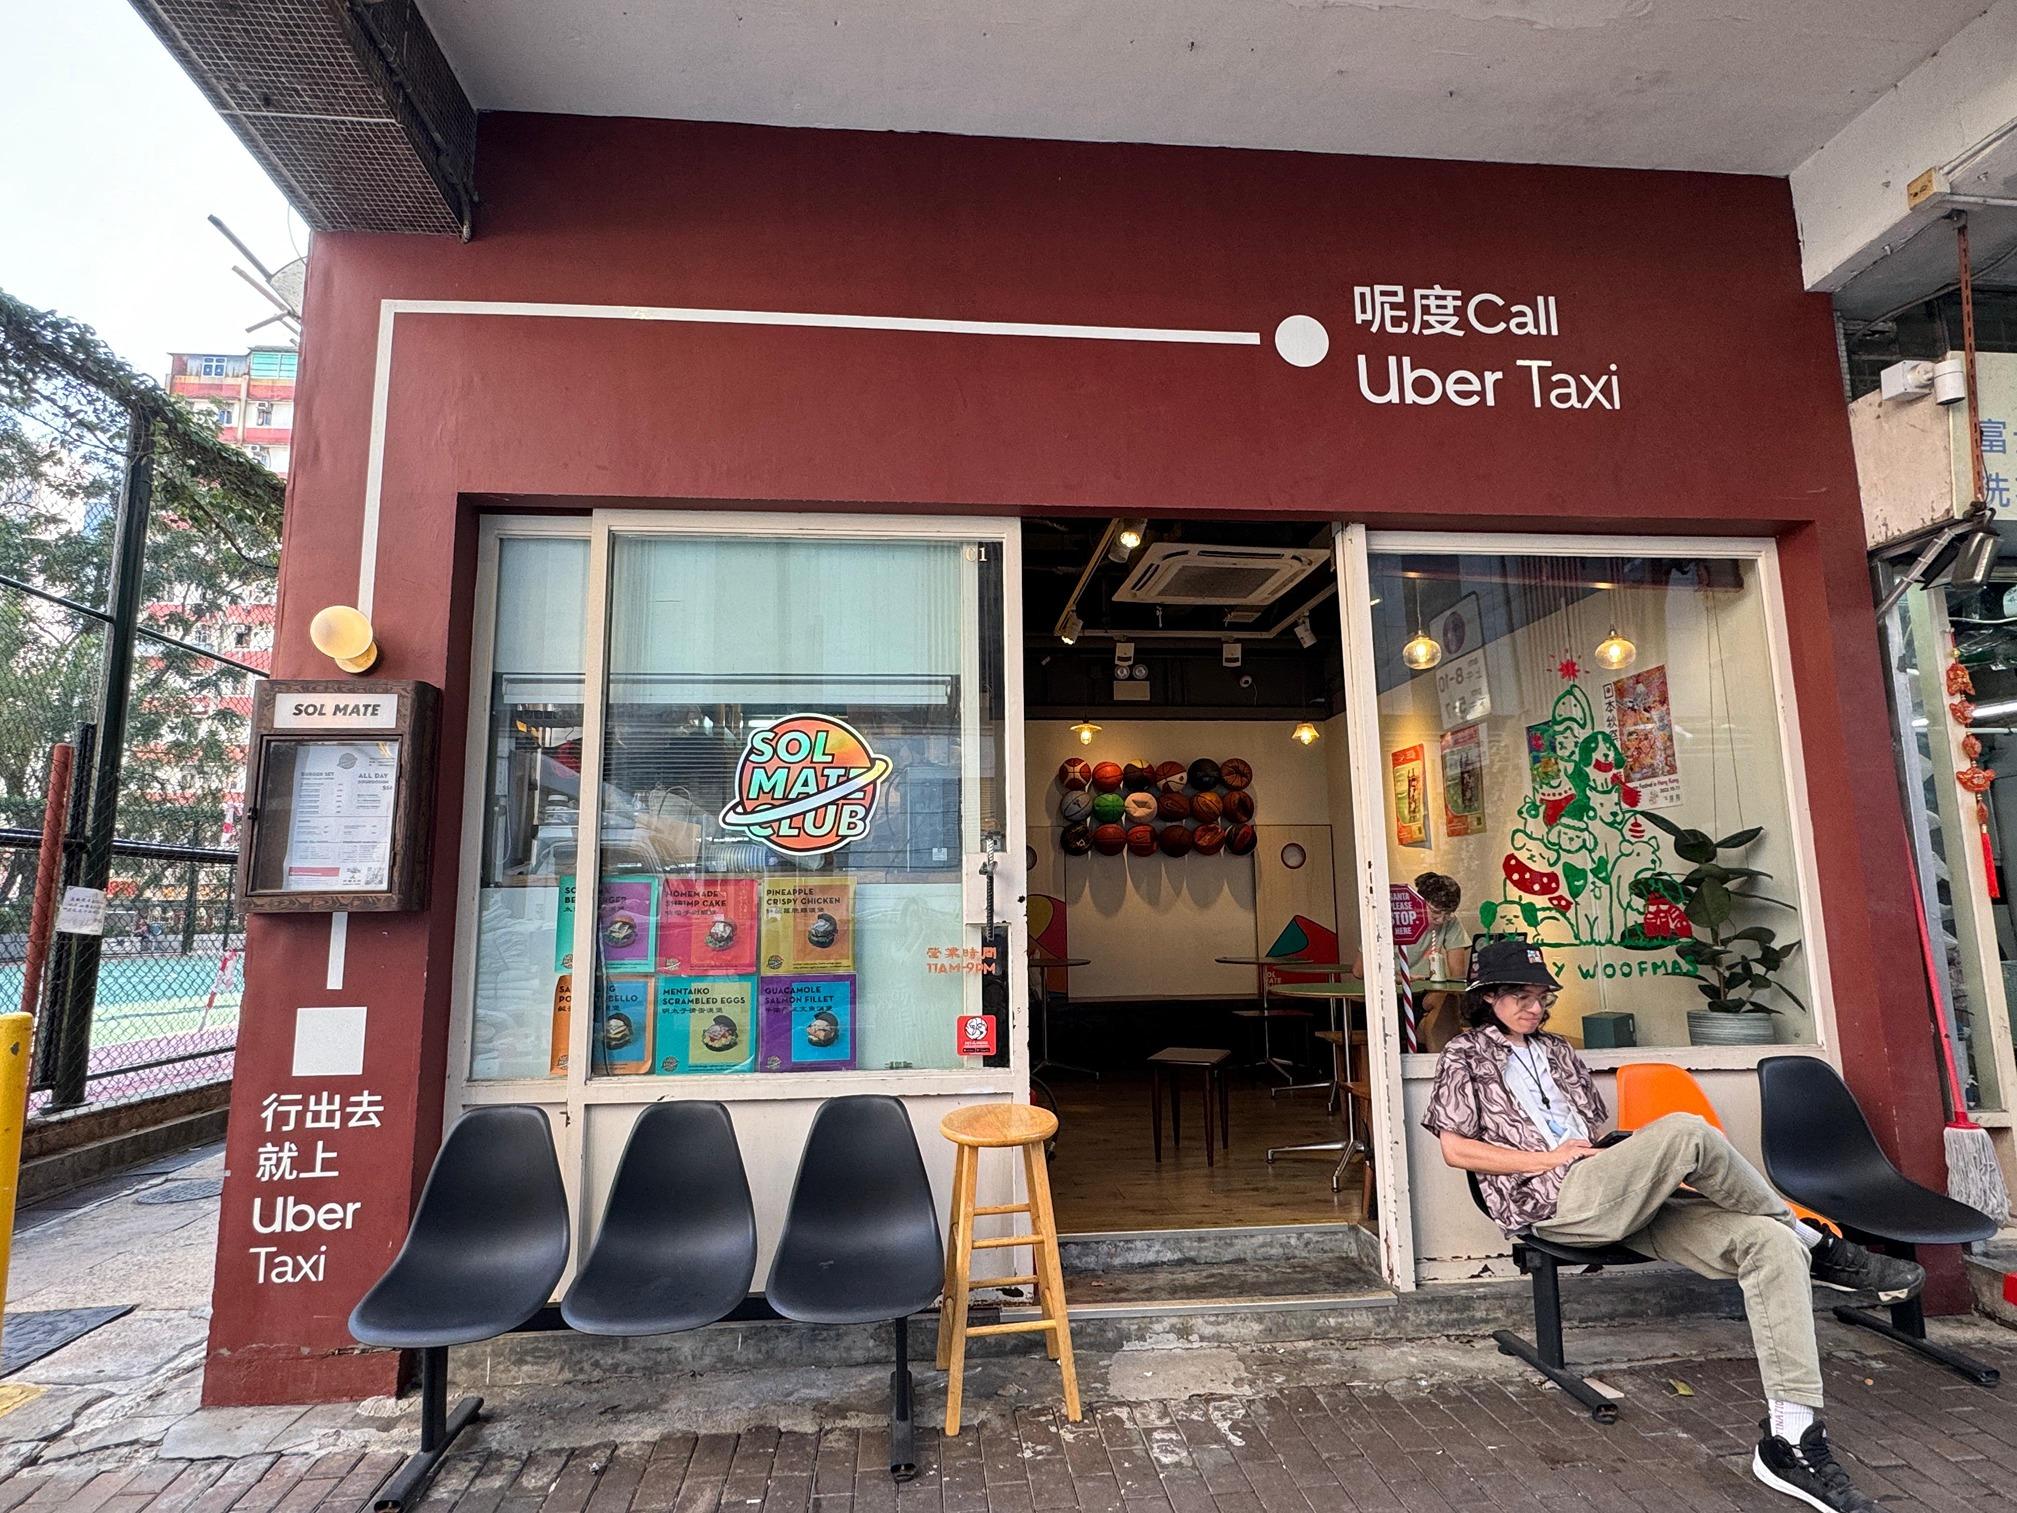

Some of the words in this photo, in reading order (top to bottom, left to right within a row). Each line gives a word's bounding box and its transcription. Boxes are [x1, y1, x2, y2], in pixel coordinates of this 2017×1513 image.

[1357, 354, 1503, 406] Uber
[1516, 359, 1621, 410] Taxi
[1980, 418, 2017, 454] 富
[292, 703, 327, 716] SOL
[332, 703, 381, 717] MATE
[749, 729, 835, 765] SOL
[766, 888, 814, 896] PINEAPPLE
[702, 899, 727, 908] CAKE
[766, 898, 797, 906] CRISPY
[800, 897, 840, 905] CHICKEN
[1390, 901, 1413, 910] LEASE
[1578, 955, 1700, 980] WOOFMAS
[662, 987, 710, 996] MENTAIKO
[764, 986, 822, 995] GUACAMOLE
[662, 997, 718, 1006] SCRAMBLED
[720, 996, 746, 1005] EGGS
[764, 996, 802, 1005] SALMON
[804, 995, 834, 1003] FILLET
[260, 1090, 385, 1133] 行出去
[256, 1140, 339, 1183] 就上
[252, 1196, 361, 1234] Uber
[249, 1245, 327, 1284] Taxi
